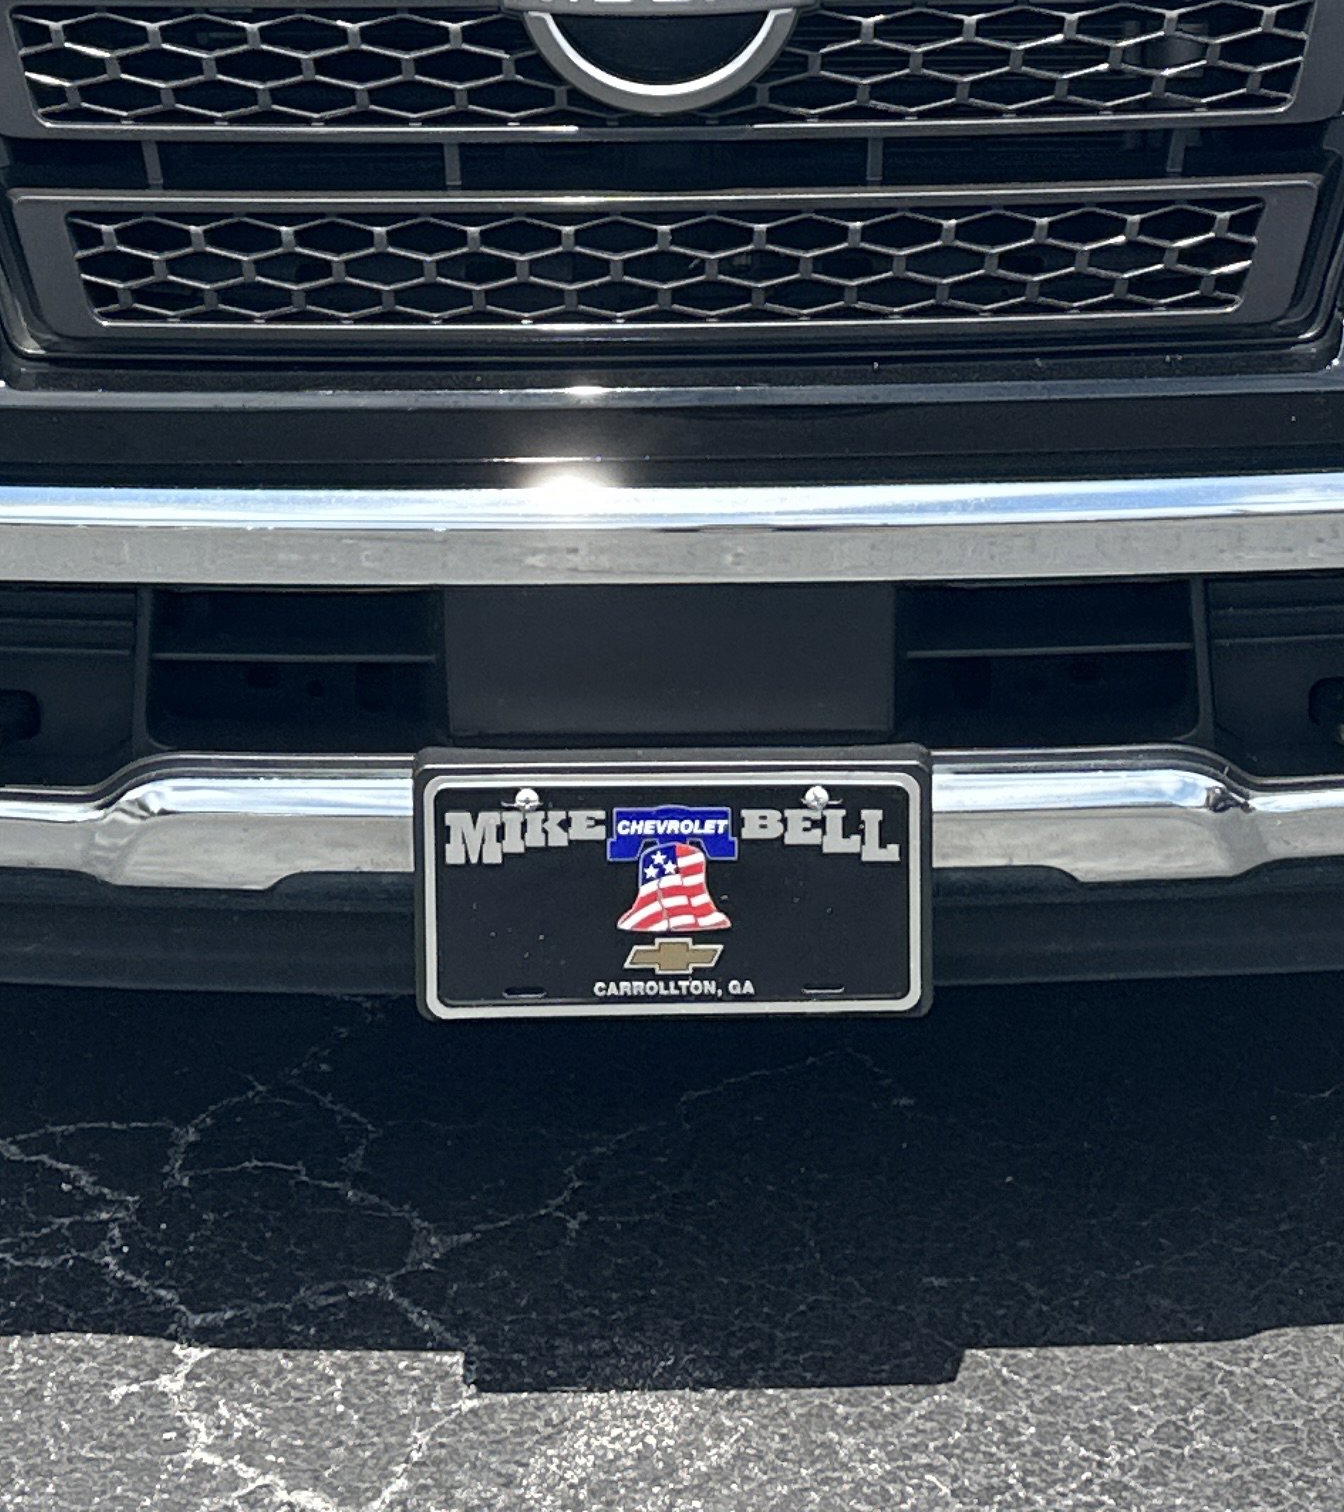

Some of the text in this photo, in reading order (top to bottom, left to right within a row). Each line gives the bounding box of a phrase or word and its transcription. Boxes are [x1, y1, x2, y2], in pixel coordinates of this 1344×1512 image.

[445, 809, 900, 864] MIKE CHEVROLET BELL
[594, 980, 755, 997] CARROLLTON, GA
